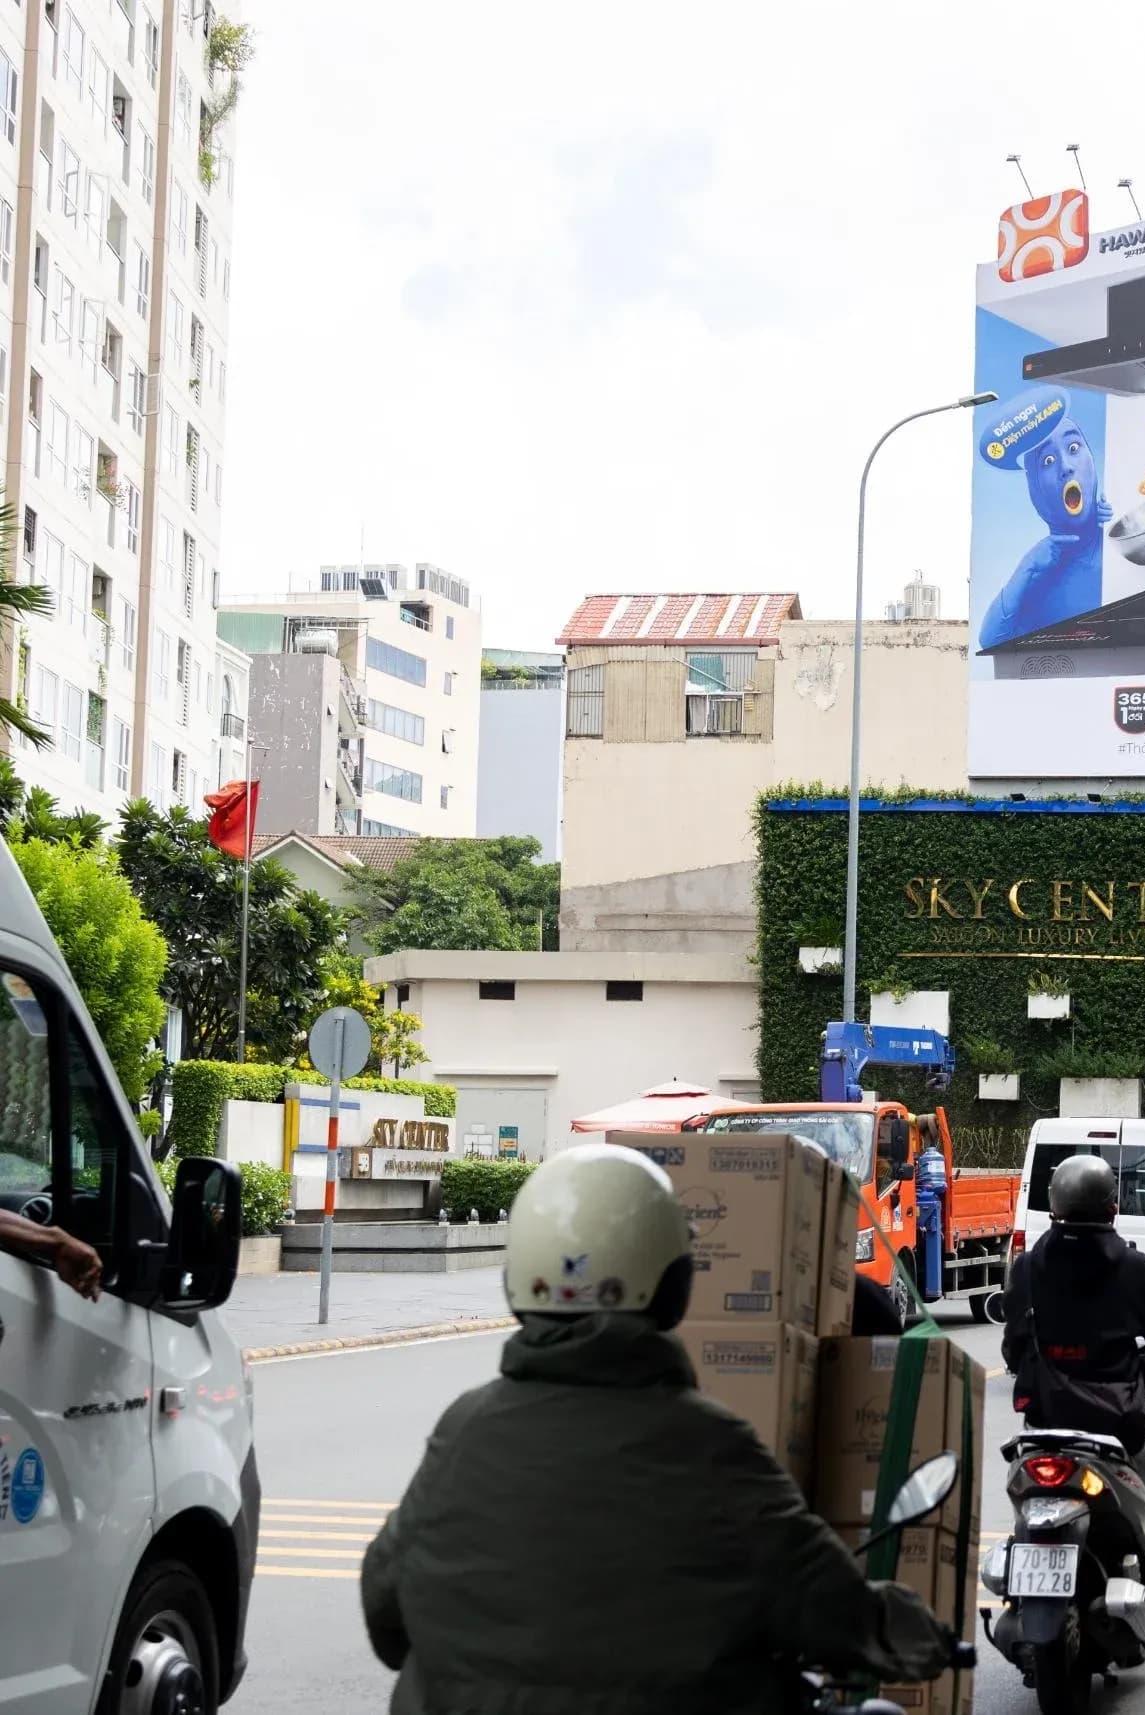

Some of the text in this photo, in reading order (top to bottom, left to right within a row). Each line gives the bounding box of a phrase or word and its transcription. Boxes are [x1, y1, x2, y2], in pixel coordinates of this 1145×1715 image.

[993, 403, 1038, 437] Đến ngay
[1120, 706, 1128, 724] 1
[903, 876, 994, 920] SKY
[1017, 927, 1100, 946] LUXURY
[1015, 1572, 1072, 1593] 112.28
